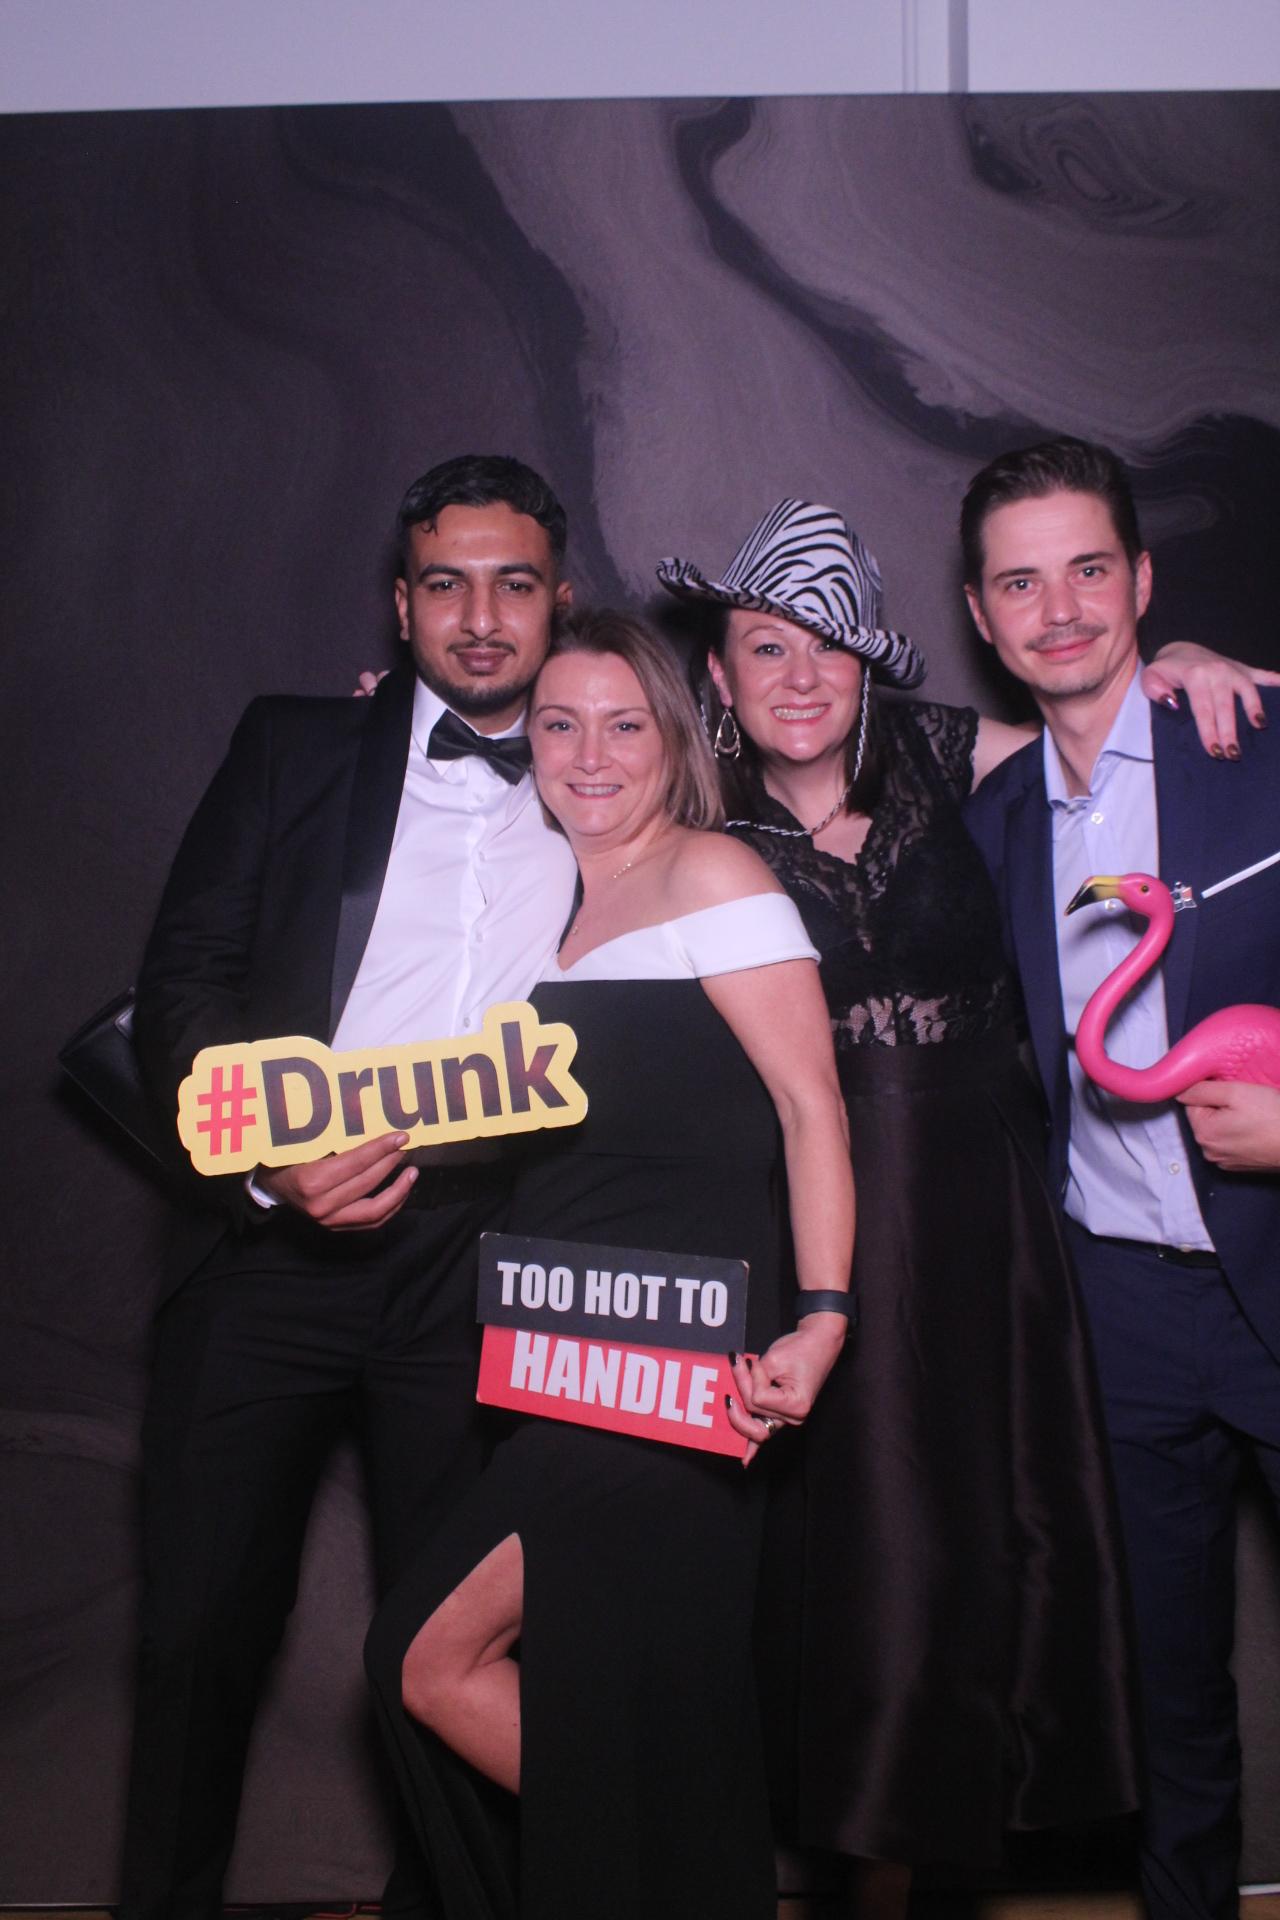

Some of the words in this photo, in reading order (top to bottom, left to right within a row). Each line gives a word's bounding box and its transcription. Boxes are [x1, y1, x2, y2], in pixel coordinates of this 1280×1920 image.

[196, 1021, 570, 1156] #Drunk
[497, 1261, 574, 1312] TOO
[584, 1270, 666, 1320] HOT
[675, 1278, 728, 1328] TO
[510, 1330, 719, 1428] HANDLE
